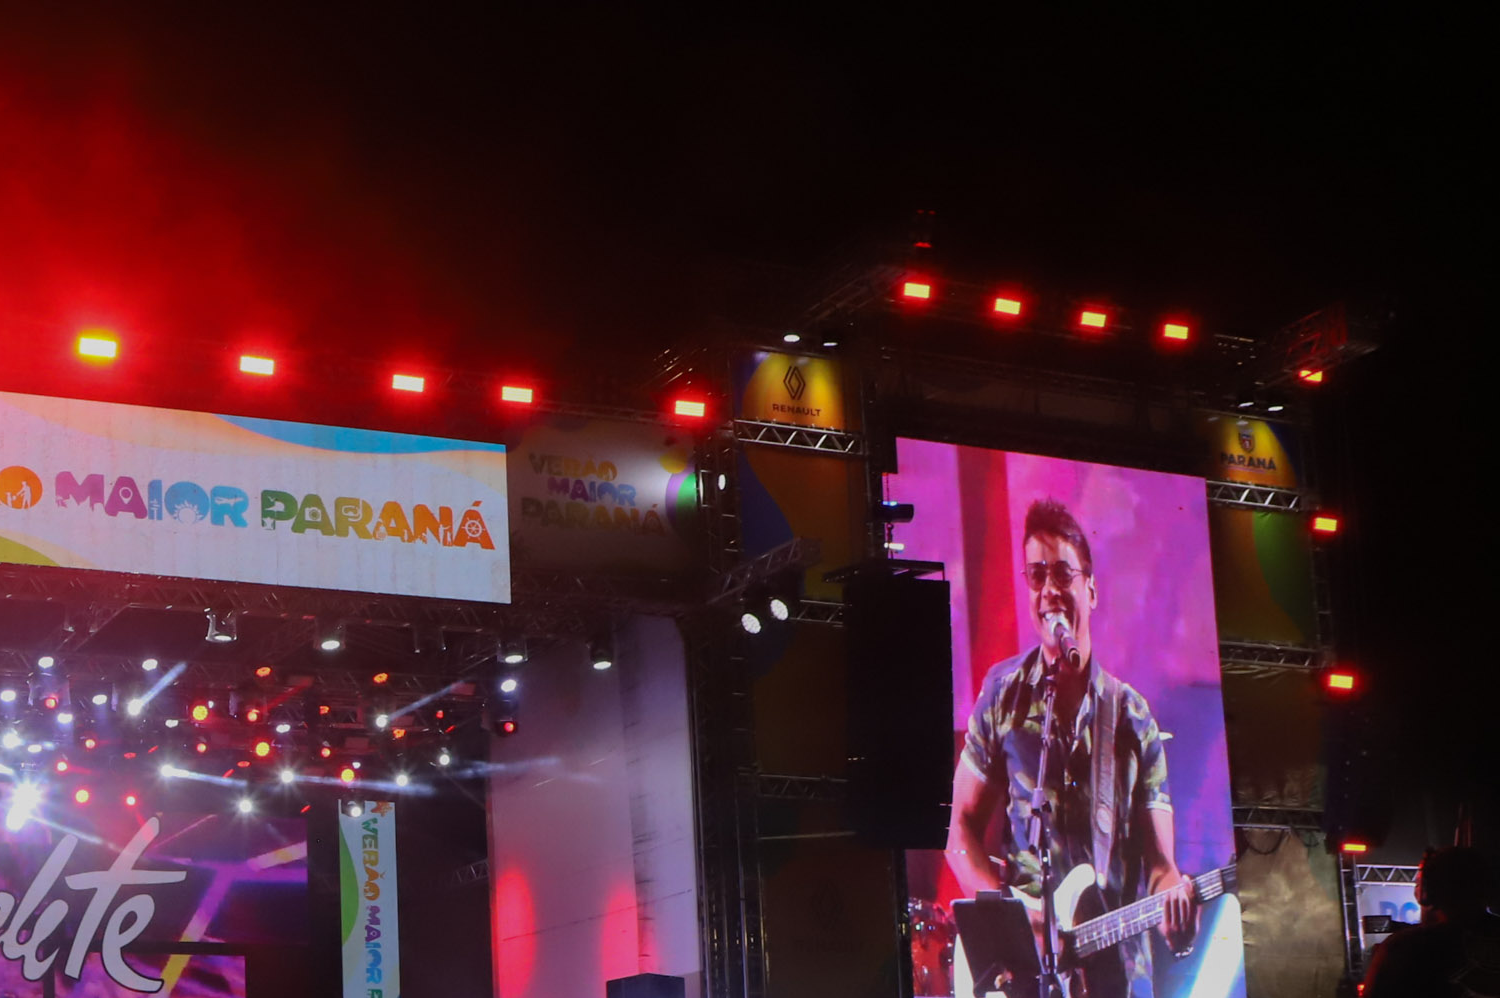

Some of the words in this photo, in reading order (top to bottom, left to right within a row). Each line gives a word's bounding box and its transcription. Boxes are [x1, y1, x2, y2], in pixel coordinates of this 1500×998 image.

[772, 403, 822, 418] RENAULT
[1220, 452, 1277, 471] PARANÁ
[54, 470, 250, 530] MAIOR
[260, 489, 496, 551] PARANÁ
[547, 477, 637, 508] MAIOR
[361, 816, 386, 901] VERÃO
[364, 904, 384, 985] MAIOR
